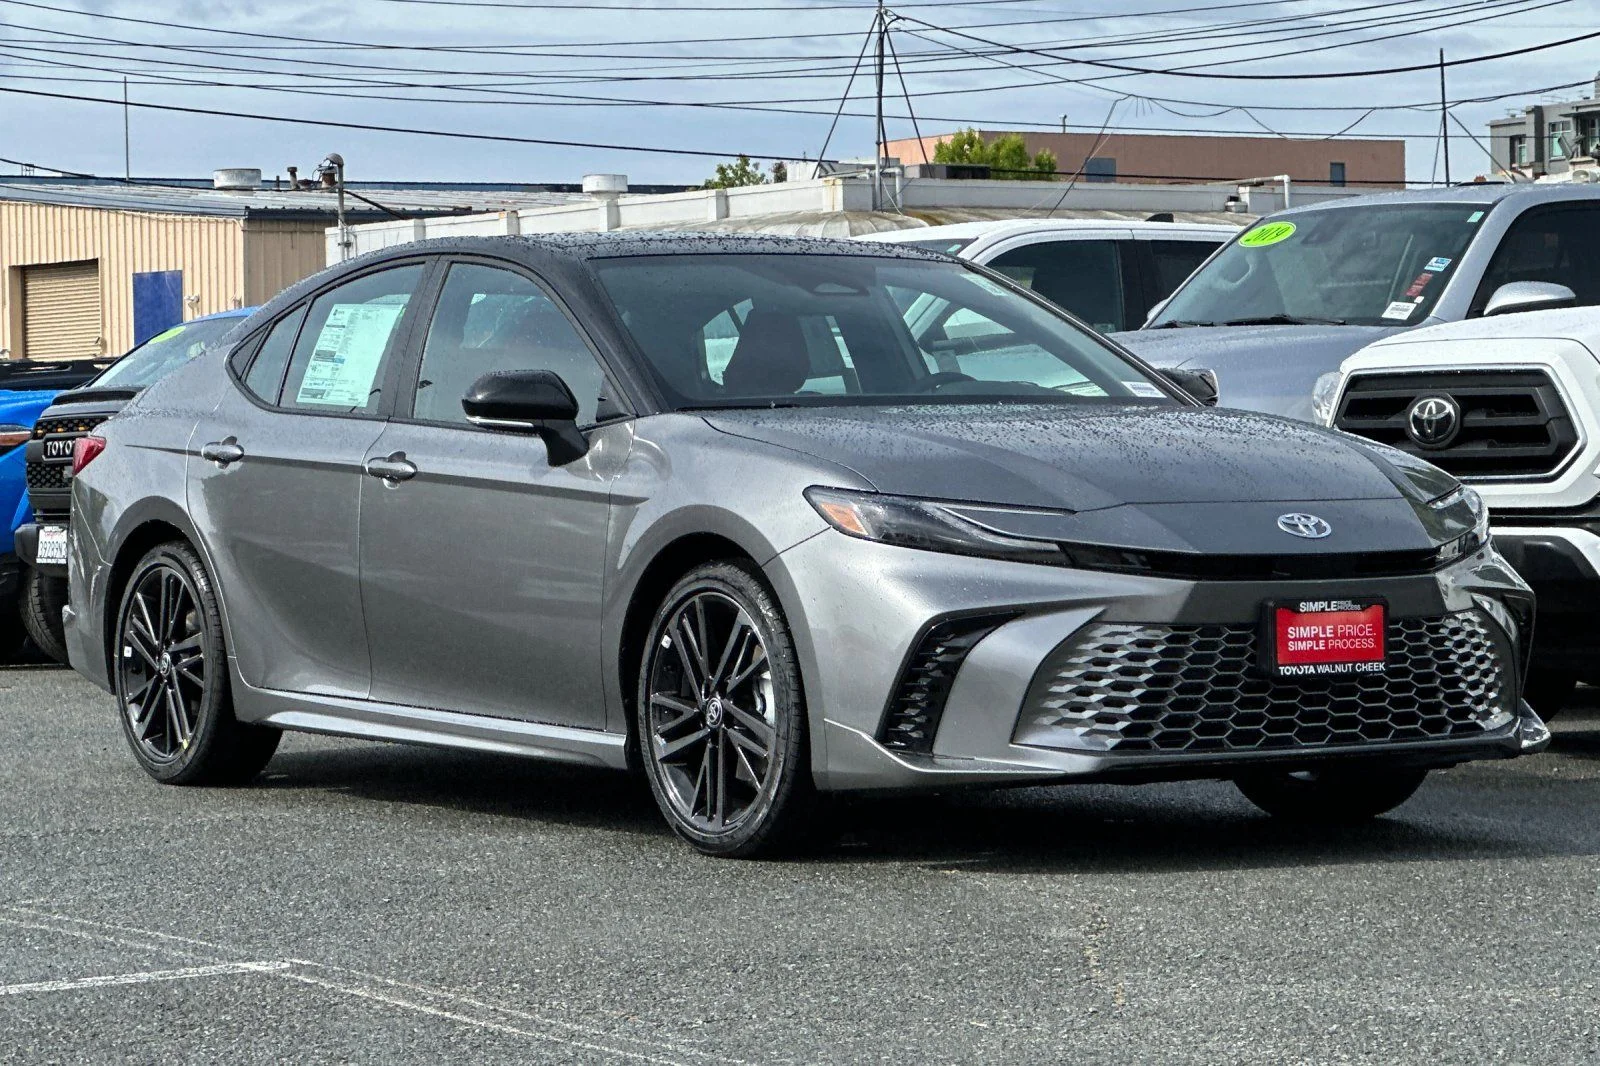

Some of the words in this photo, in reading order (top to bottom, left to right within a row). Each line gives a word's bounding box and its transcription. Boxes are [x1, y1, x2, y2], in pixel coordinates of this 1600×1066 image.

[46, 440, 76, 456] TOYO
[1299, 600, 1338, 612] SIMPLE
[1287, 625, 1334, 639] SIMPLE
[1337, 624, 1377, 637] PRICE.
[1288, 640, 1326, 651] SIMPLE
[1328, 638, 1377, 649] PROCESS.
[1279, 664, 1316, 676] TOYOTA
[1316, 663, 1353, 673] WALNUT
